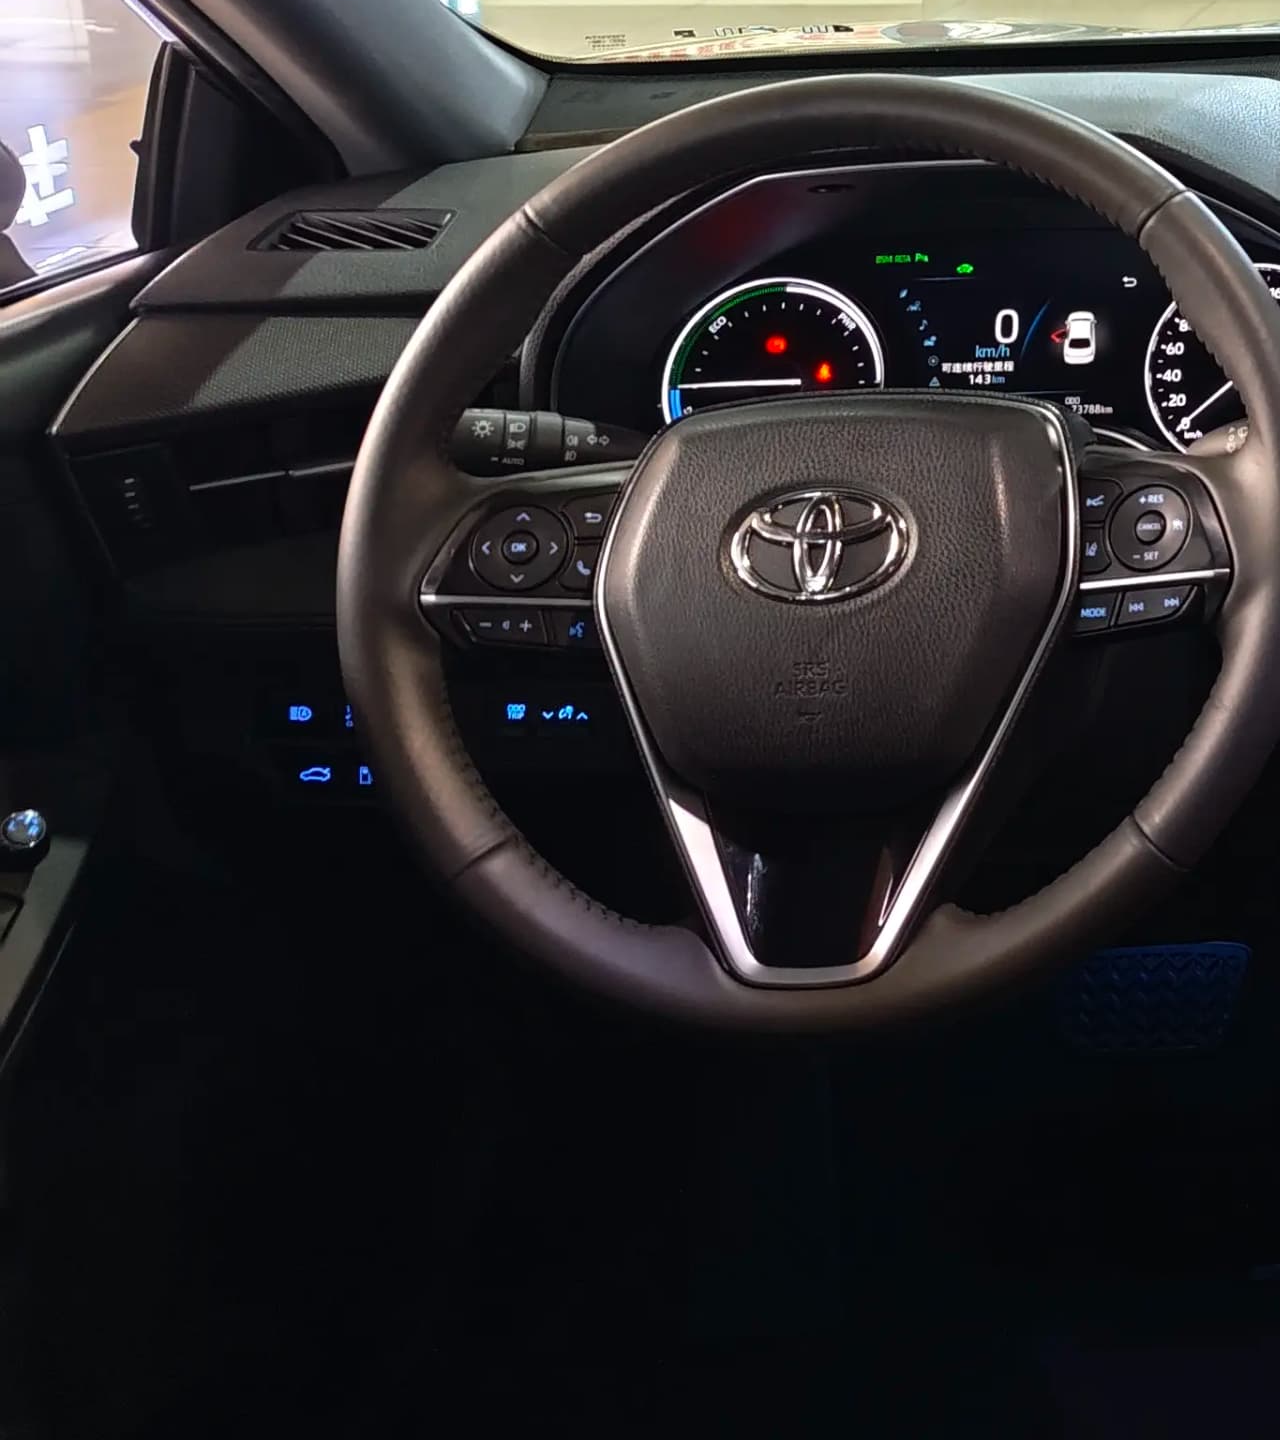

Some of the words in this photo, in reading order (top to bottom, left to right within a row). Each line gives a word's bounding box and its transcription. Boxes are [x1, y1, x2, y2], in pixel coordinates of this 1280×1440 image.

[708, 315, 727, 334] ECO
[837, 311, 858, 332] PWR
[994, 308, 1020, 344] 0
[1178, 318, 1193, 332] 8
[974, 344, 1011, 359] km/h
[1165, 341, 1185, 356] 60
[1161, 368, 1182, 382] 40
[1167, 393, 1188, 407] 20
[511, 542, 528, 553] OK
[1080, 607, 1107, 619] MODE
